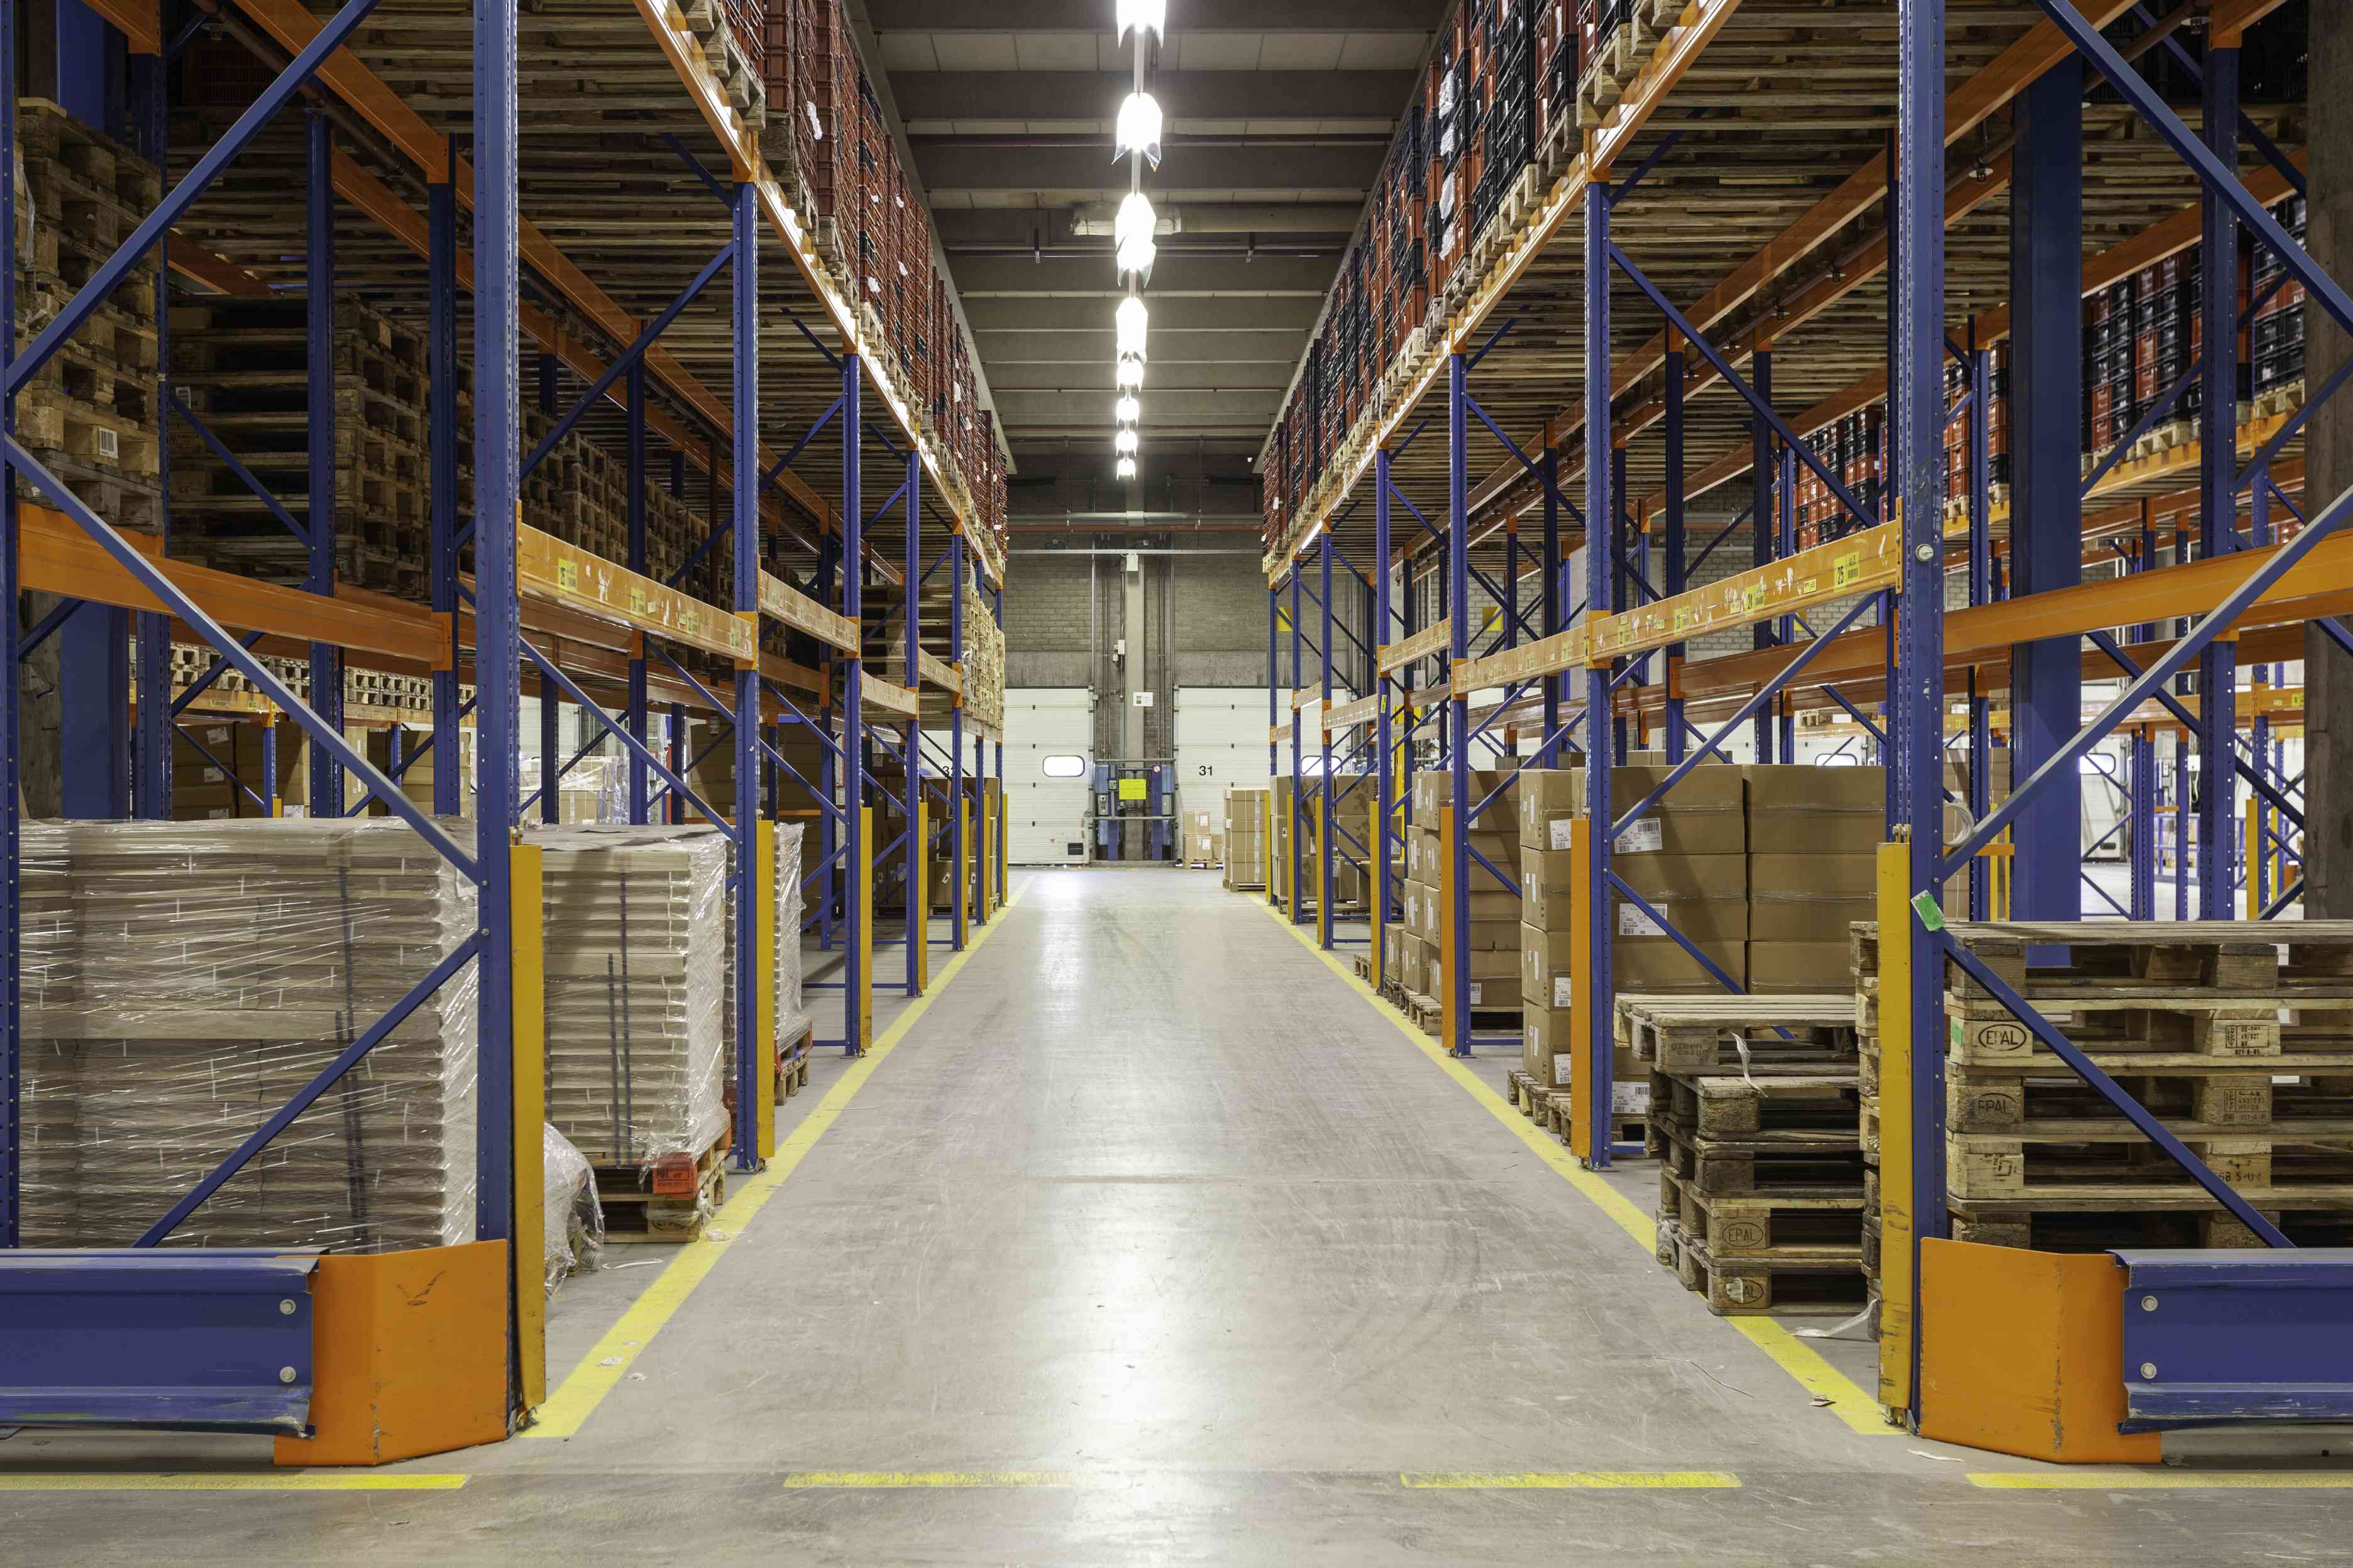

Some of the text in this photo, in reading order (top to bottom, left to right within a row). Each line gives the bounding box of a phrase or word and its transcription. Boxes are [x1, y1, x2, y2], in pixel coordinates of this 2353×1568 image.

[1838, 566, 1844, 584] 25
[1199, 765, 1213, 776] 31
[1986, 1030, 2018, 1045] EPAL
[1978, 1100, 2010, 1115] EPAL
[1729, 1228, 1756, 1242] EPAL
